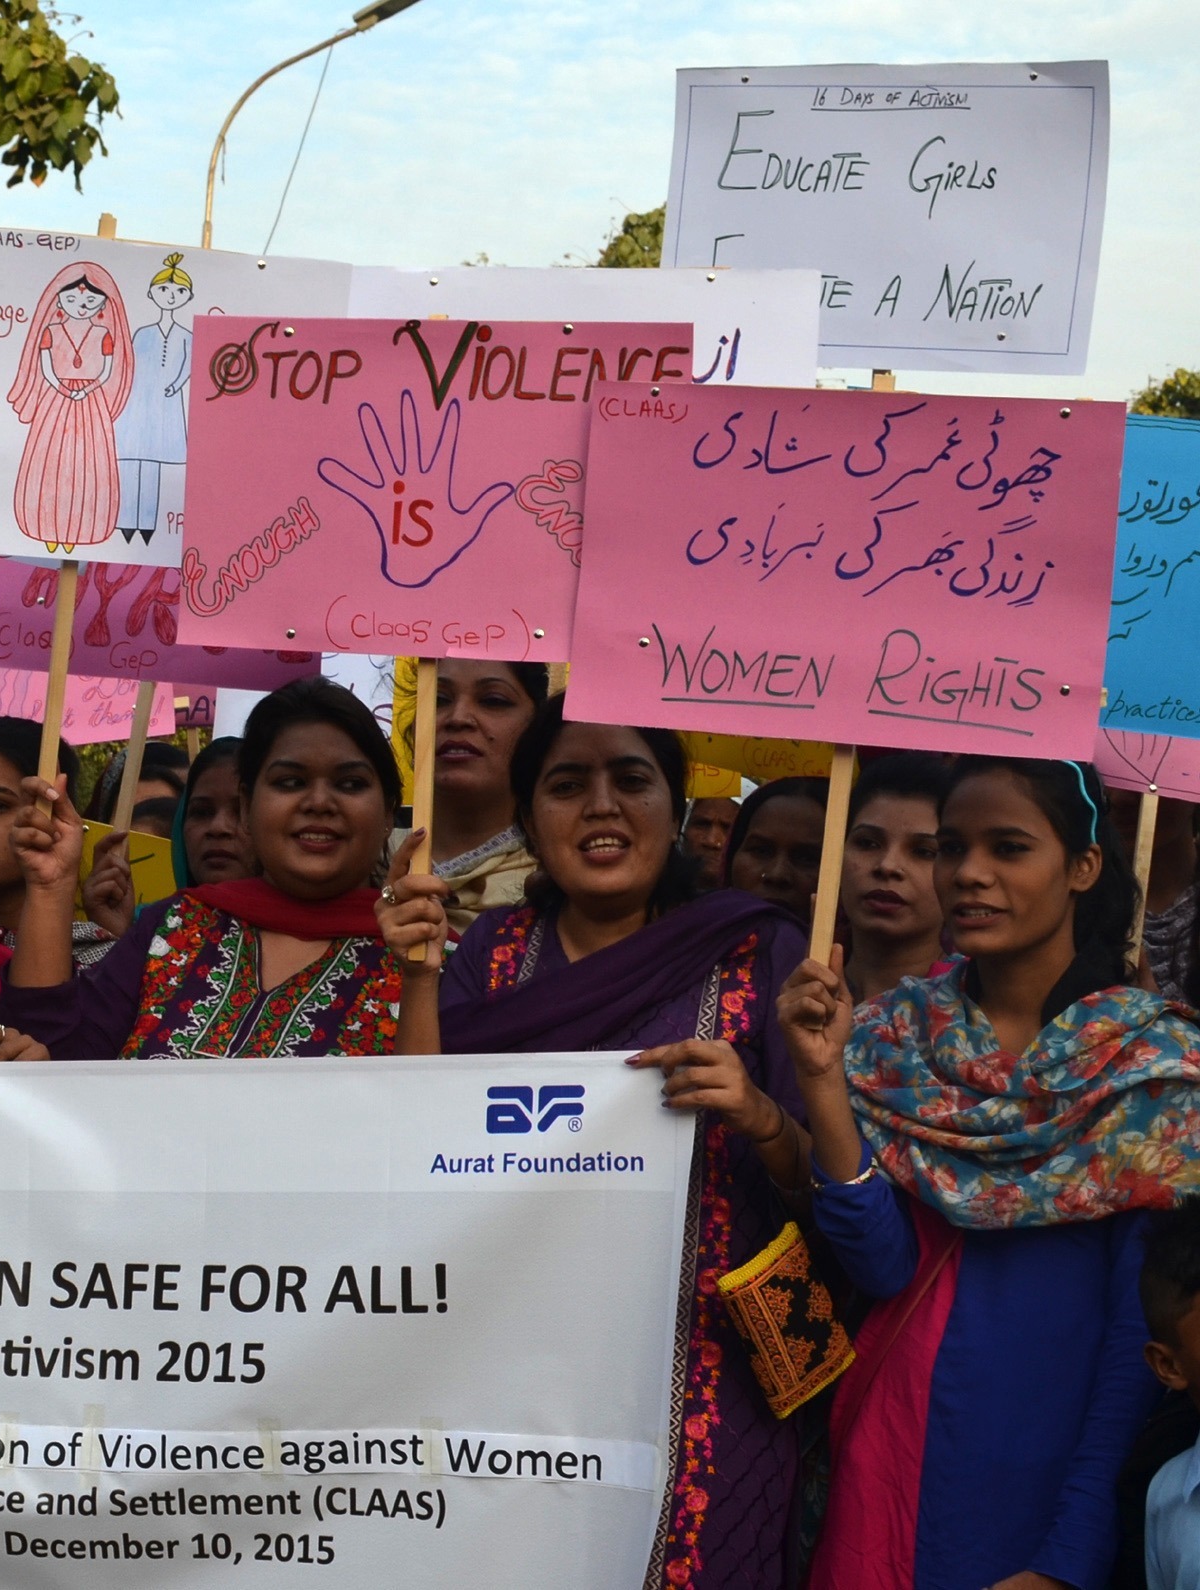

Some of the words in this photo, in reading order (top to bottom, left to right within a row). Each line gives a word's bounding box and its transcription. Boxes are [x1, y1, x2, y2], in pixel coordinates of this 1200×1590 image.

[813, 88, 828, 106] 16
[718, 110, 870, 193] EDUCATE
[875, 275, 901, 317] A
[600, 397, 688, 423] (CLAAS)
[652, 623, 835, 698] WOMEN
[430, 1153, 495, 1174] Aurat
[502, 1151, 644, 1173] Foundation
[50, 1262, 180, 1311] SAFE
[201, 1264, 307, 1313] FOR
[324, 1263, 449, 1314] ALL!
[156, 1341, 266, 1384] 2015
[44, 1432, 82, 1466] of
[98, 1433, 265, 1471] Violence
[280, 1432, 424, 1473] against
[446, 1437, 603, 1481] Women
[36, 1486, 98, 1516] and
[109, 1488, 301, 1516] Settlement
[313, 1487, 447, 1528] (CLAAS)
[4, 1530, 179, 1560] December
[191, 1532, 242, 1564] 10,
[253, 1534, 335, 1564] 2015
